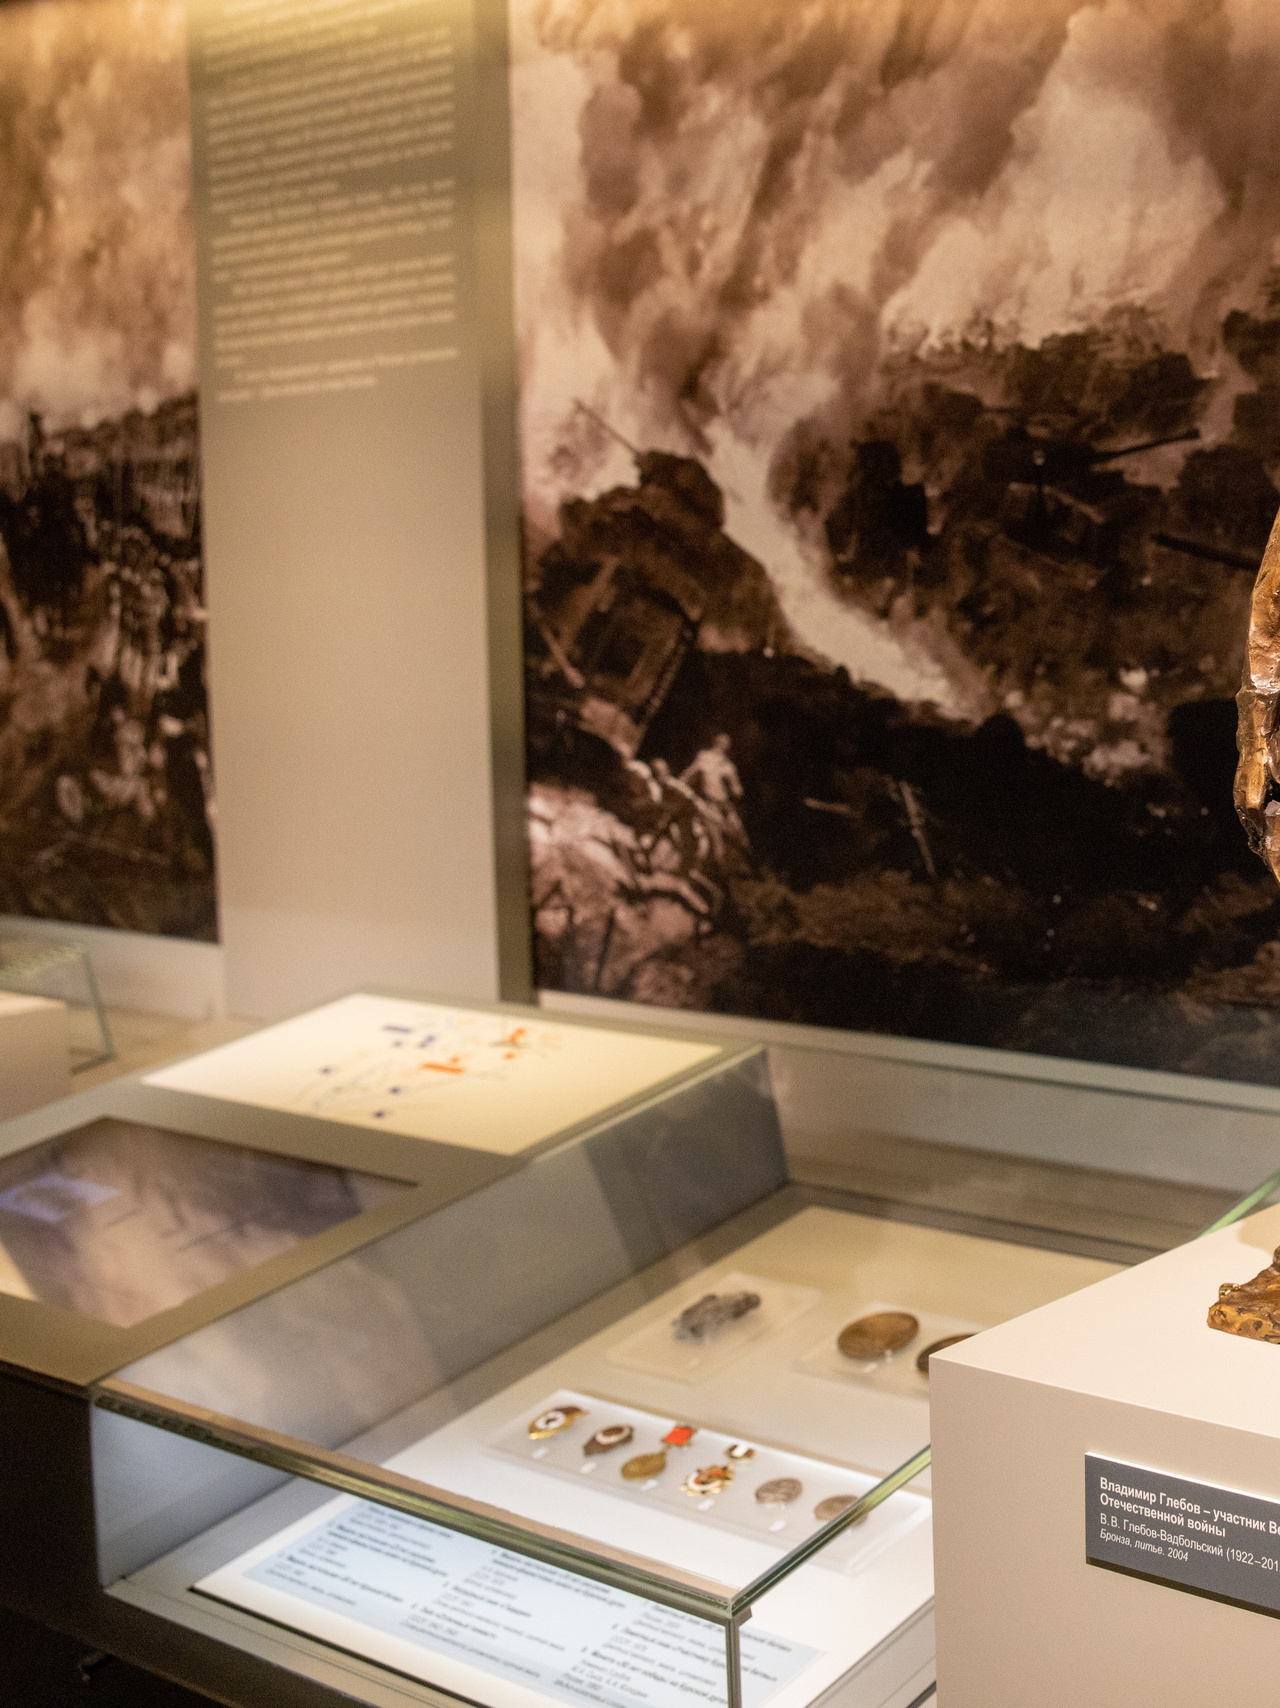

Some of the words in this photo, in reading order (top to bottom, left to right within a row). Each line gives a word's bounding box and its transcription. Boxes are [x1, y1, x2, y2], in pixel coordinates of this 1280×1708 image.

[1100, 1476, 1157, 1506] Владимир
[1159, 1492, 1201, 1515] Глебов
[1213, 1508, 1266, 1532] участник
[1100, 1492, 1185, 1527] Отечественной
[1187, 1518, 1226, 1538] войны
[1100, 1528, 1133, 1549] Бронза,
[1134, 1539, 1165, 1556] литье.
[1167, 1547, 1190, 1562] 2004
[1123, 1518, 1224, 1558] Глебов-Вадбольский
